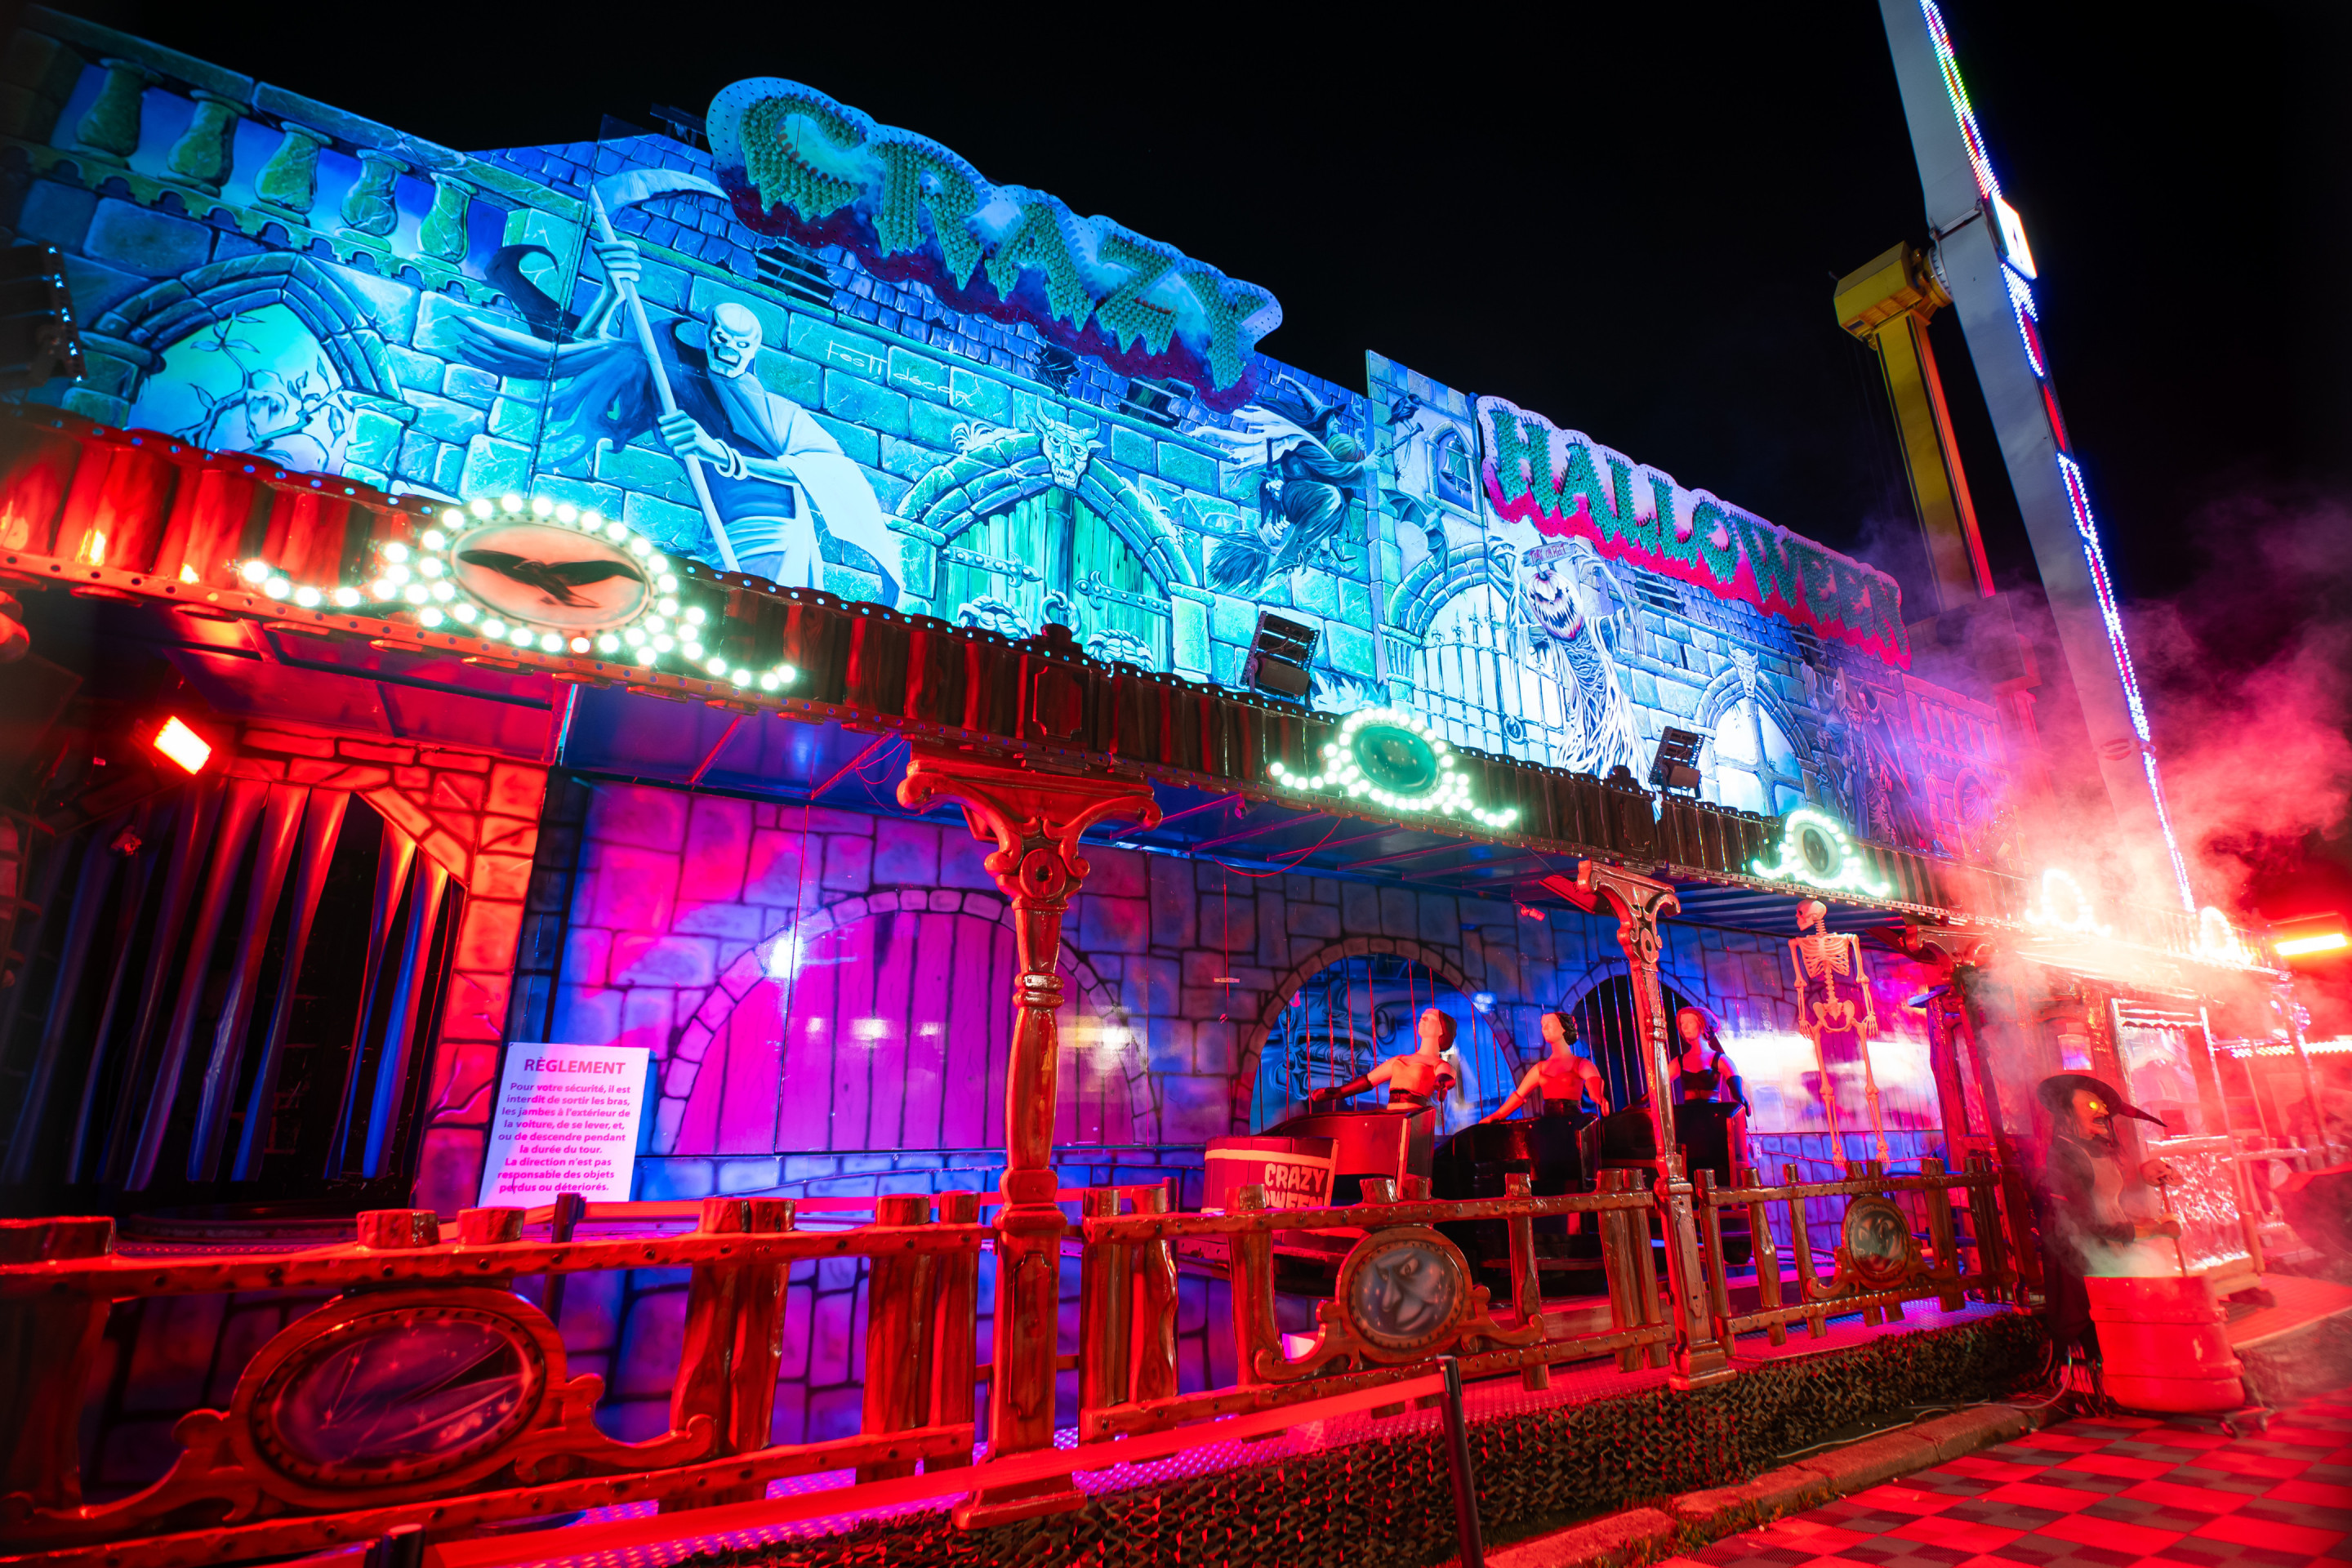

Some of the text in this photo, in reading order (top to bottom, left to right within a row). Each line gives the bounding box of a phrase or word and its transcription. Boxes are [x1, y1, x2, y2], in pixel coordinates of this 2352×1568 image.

[739, 92, 1269, 394] CRAZY
[1488, 409, 1912, 659] HALLOWEEN
[524, 1057, 626, 1074] RÈGLEMENT
[510, 1082, 535, 1091] Pour
[565, 1084, 606, 1094] sécurité,
[507, 1095, 545, 1103] interdit
[547, 1096, 560, 1104] de
[591, 1097, 605, 1105] les
[607, 1097, 630, 1106] bras,
[518, 1108, 555, 1117] jambes
[504, 1120, 513, 1128] la
[516, 1120, 555, 1129] voiture,
[557, 1120, 569, 1129] de
[585, 1121, 610, 1129] lever,
[612, 1122, 624, 1130] et,
[530, 1133, 581, 1141] descendre
[584, 1134, 626, 1143] pendant
[519, 1145, 528, 1153] la
[531, 1145, 561, 1153] durée
[497, 1169, 614, 1179] responsable des objets
[1265, 1163, 1325, 1192] CRAZY
[499, 1183, 536, 1193] perdus
